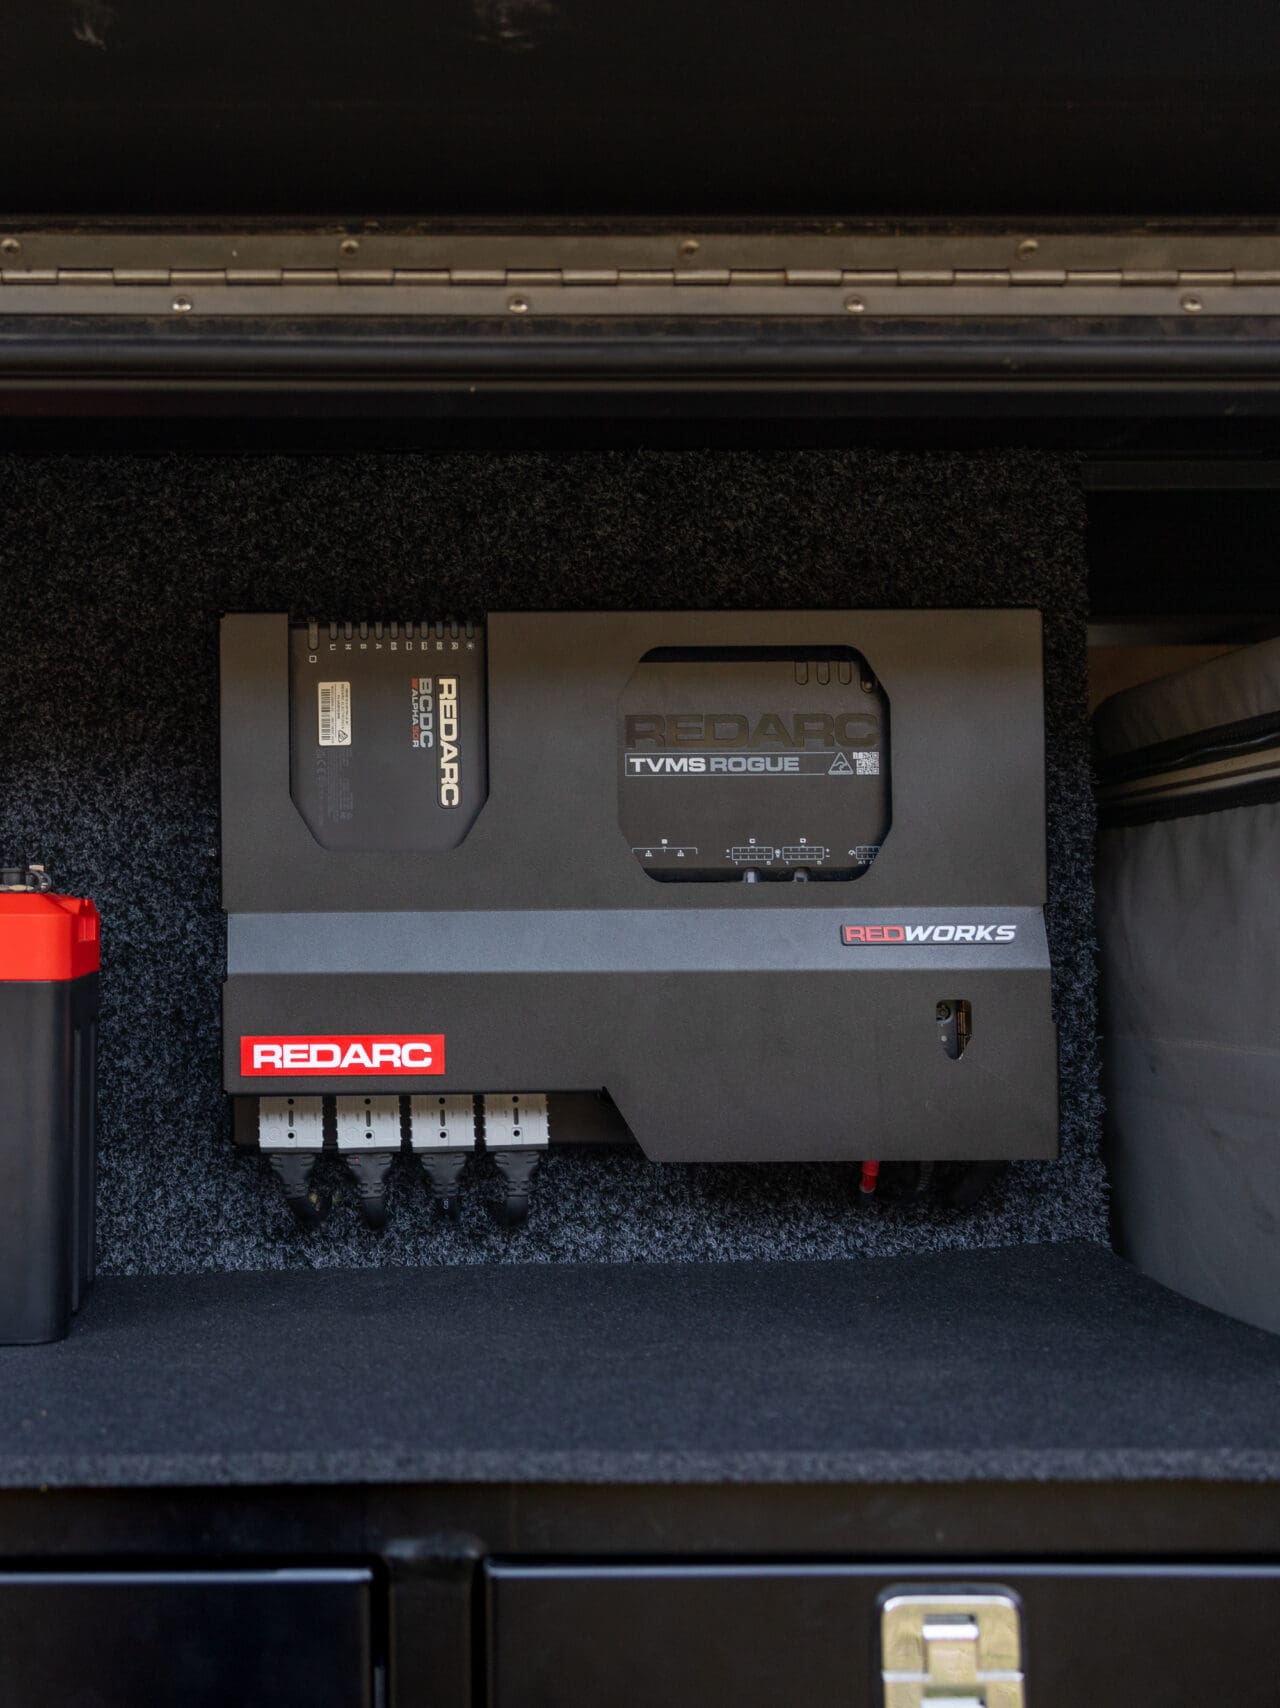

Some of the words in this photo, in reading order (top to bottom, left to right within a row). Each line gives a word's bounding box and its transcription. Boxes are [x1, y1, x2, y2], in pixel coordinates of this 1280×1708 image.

[418, 677, 433, 748] BCDC
[438, 678, 460, 807] REDARC
[624, 713, 880, 749] REDARC
[629, 757, 706, 773] TVMS
[709, 757, 800, 772] ROGUE
[844, 925, 1018, 943] REDWORKS
[253, 1042, 433, 1070] REDARC
